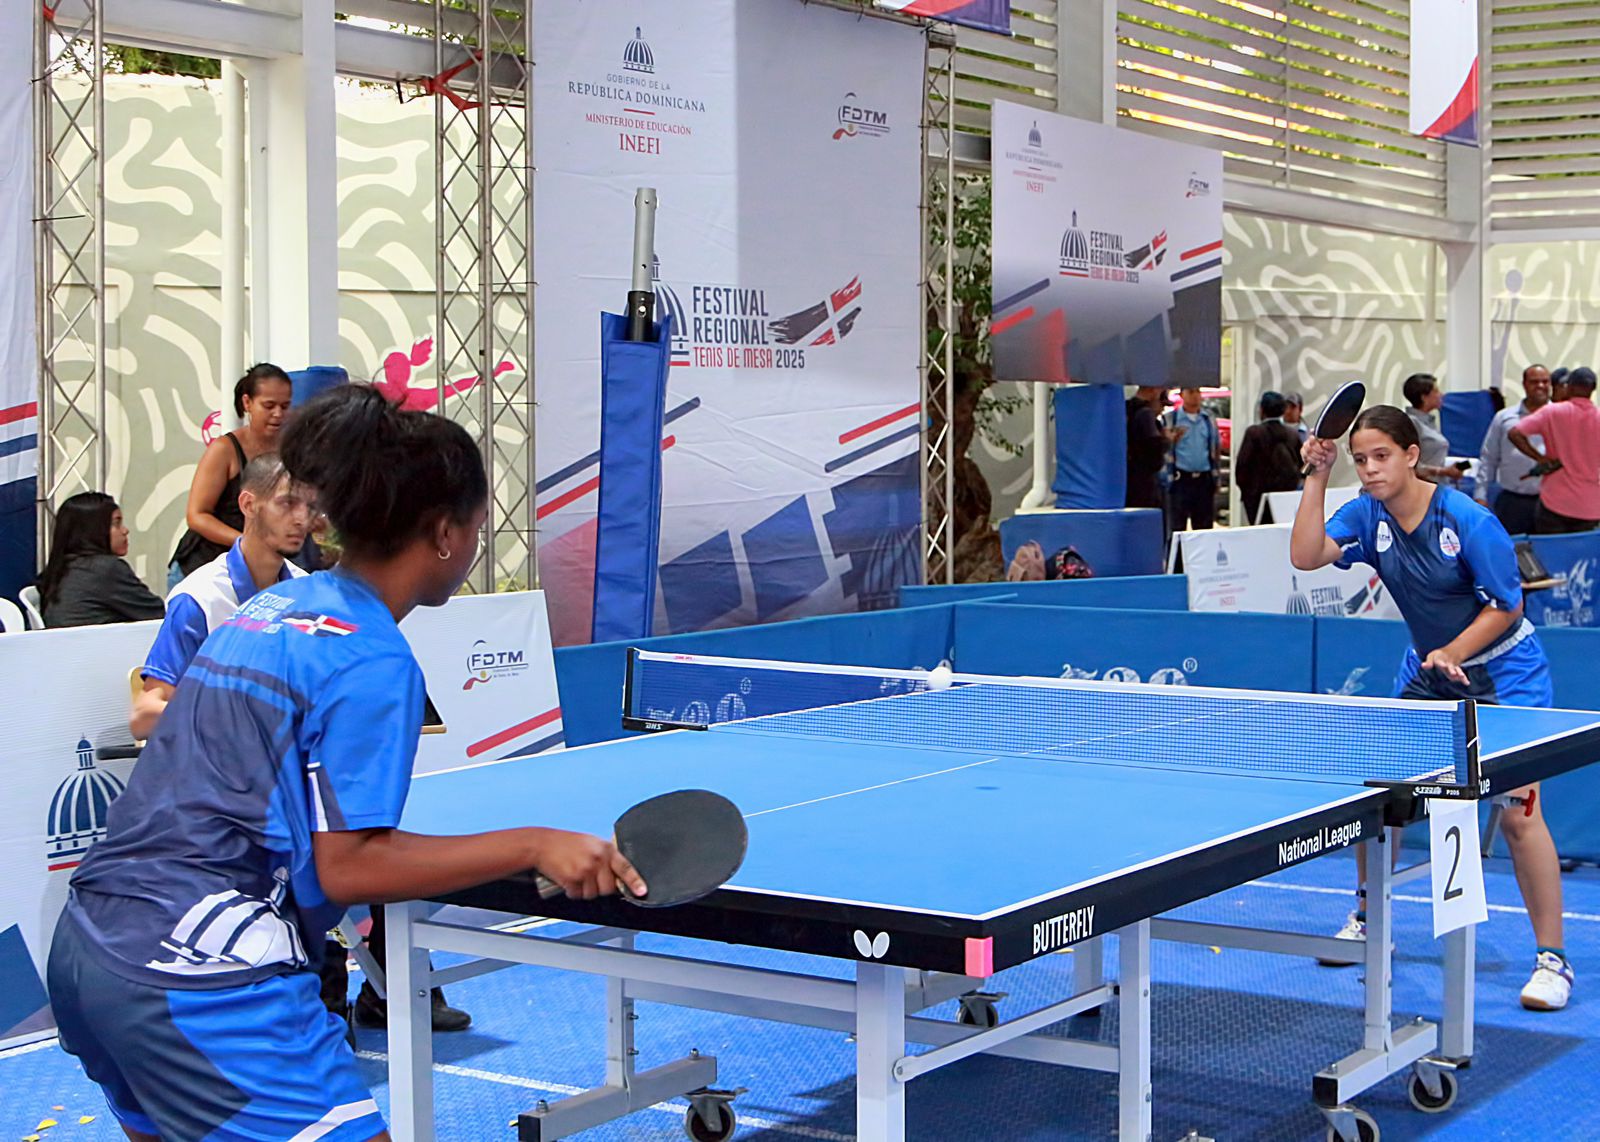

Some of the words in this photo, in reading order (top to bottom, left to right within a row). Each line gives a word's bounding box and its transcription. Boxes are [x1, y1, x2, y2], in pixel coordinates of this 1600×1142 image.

[606, 73, 647, 87] GOBIERNO
[649, 80, 659, 90] DE
[661, 82, 671, 91] LA
[635, 91, 706, 113] DOMINICANA
[585, 112, 634, 129] MINISTERIO
[635, 119, 645, 130] DE
[842, 105, 887, 125] FDTM
[619, 132, 660, 155] INEFI
[1090, 230, 1124, 251] FESTIVAL
[1090, 249, 1124, 268] REGIONAL
[693, 286, 769, 317] FESTIVAL
[693, 317, 769, 345] REGIONAL
[693, 346, 723, 368] TENIS
[727, 347, 740, 369] DE
[743, 348, 773, 369] MESA
[776, 349, 805, 369] 2025
[1311, 586, 1344, 606] FESTIVAL
[471, 650, 523, 667] FDTM
[1278, 828, 1323, 866] National
[1325, 820, 1362, 847] League
[1443, 825, 1464, 901] 2
[1033, 904, 1095, 955] BUTTERFLY
